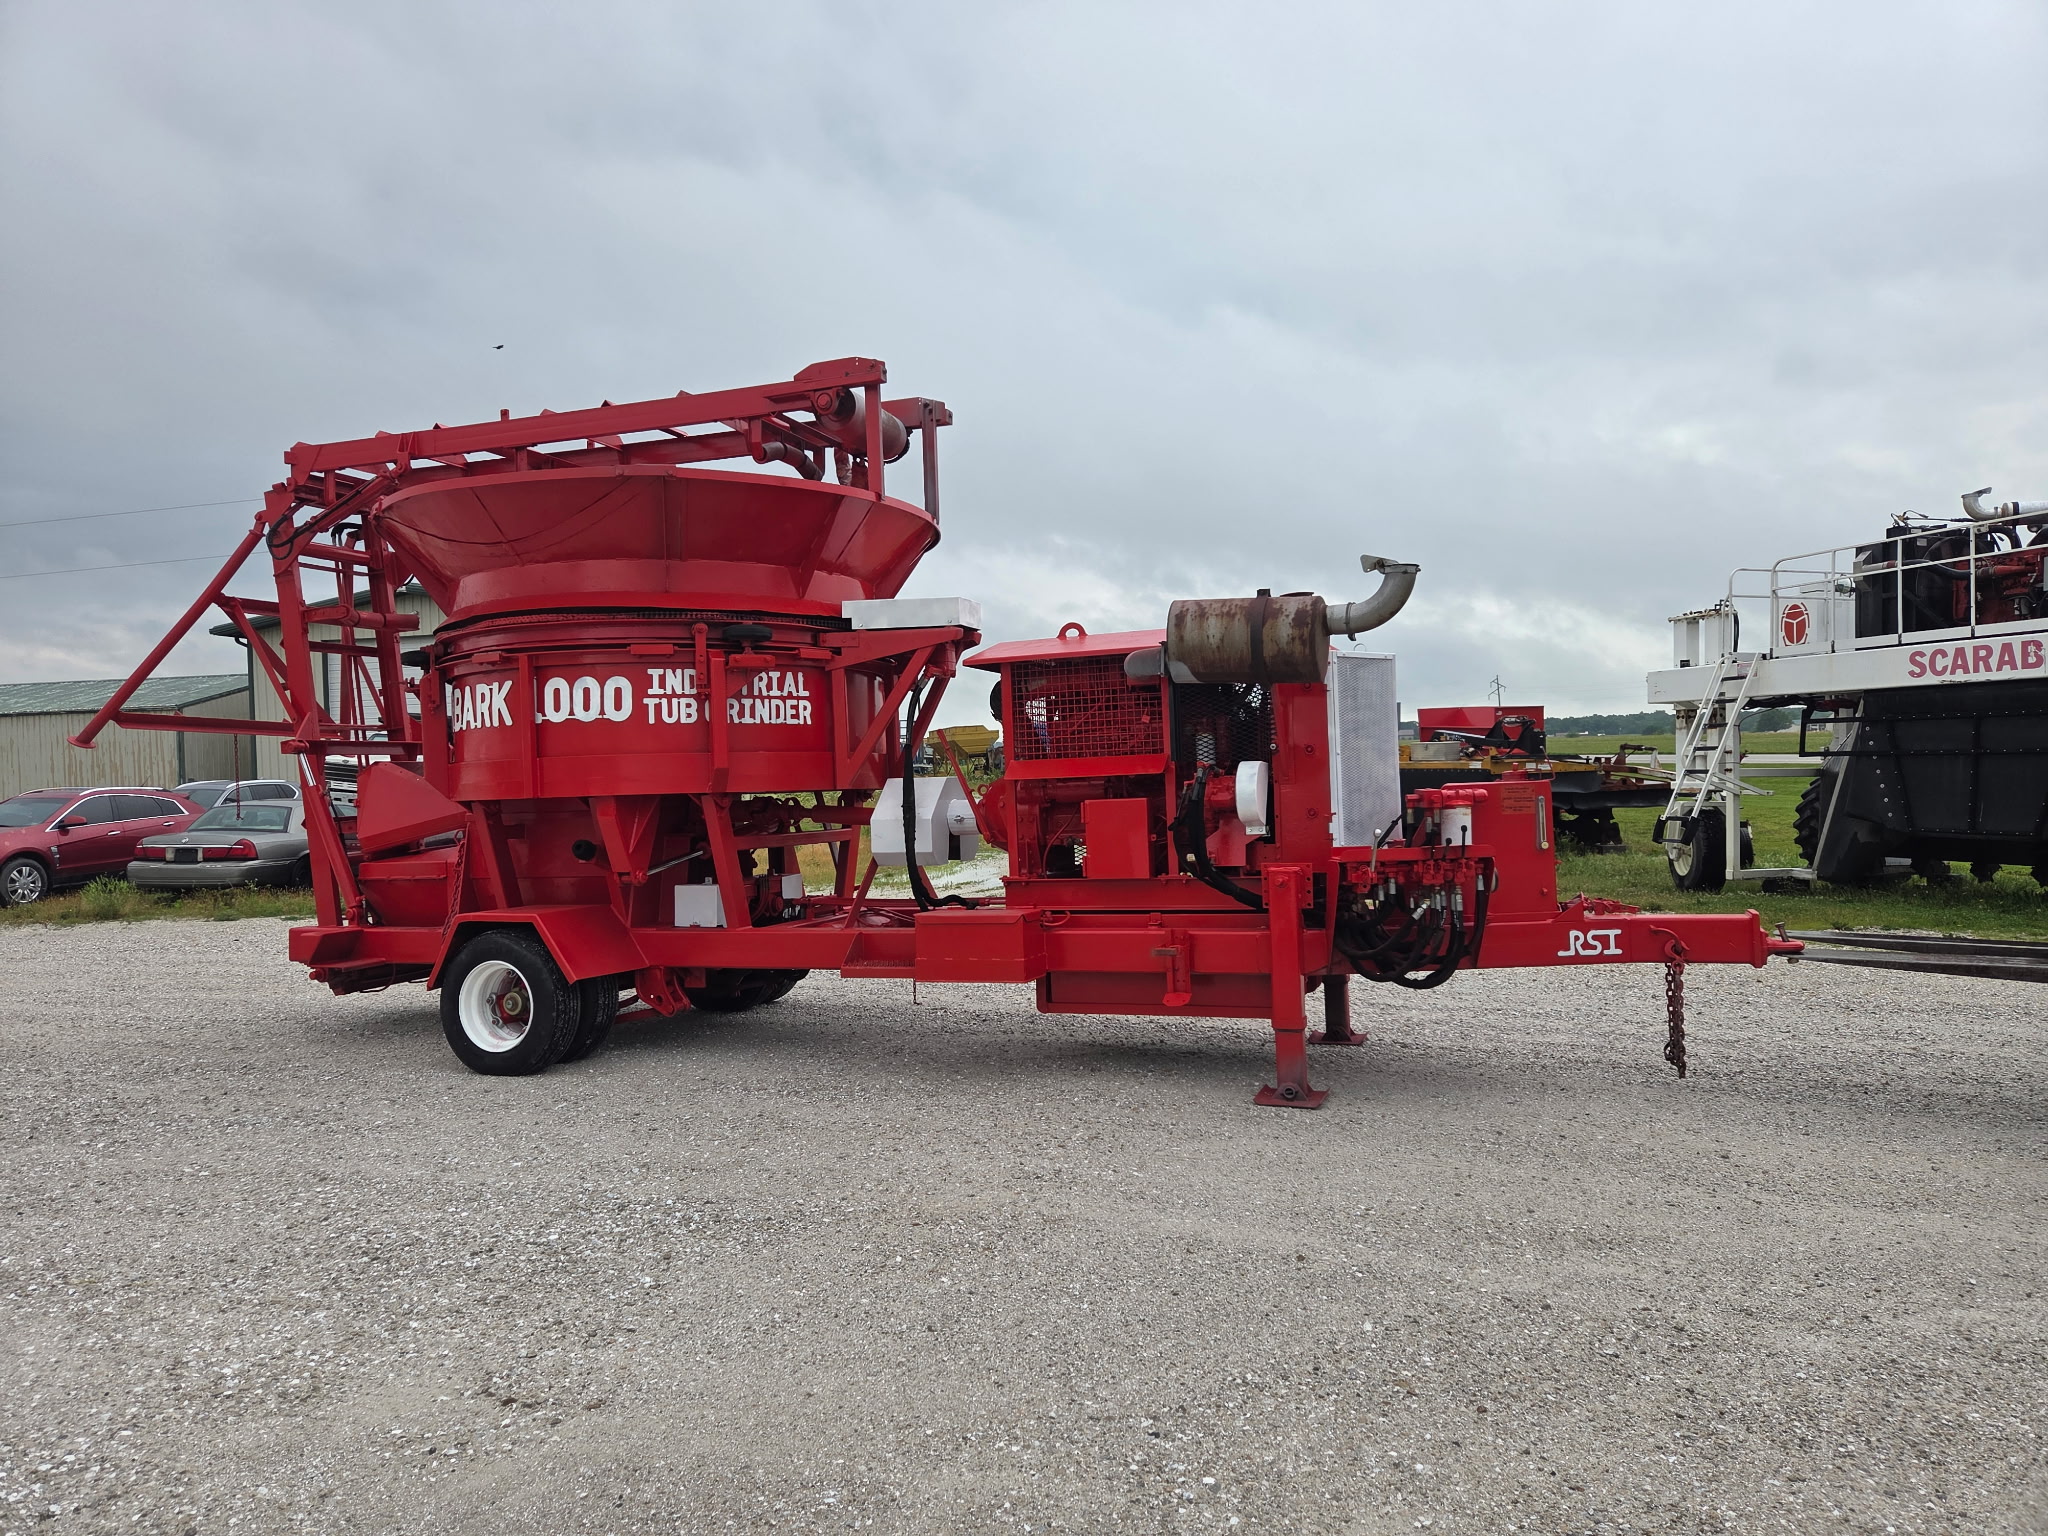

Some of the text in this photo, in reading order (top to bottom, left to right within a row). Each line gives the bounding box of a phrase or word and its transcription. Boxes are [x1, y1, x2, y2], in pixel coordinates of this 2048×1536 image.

[1907, 639, 2044, 679] SCARAB
[647, 668, 810, 697] INDRIAL
[453, 675, 633, 733] BARK 000
[643, 697, 812, 725] TUB RINDER
[1557, 929, 1623, 957] RSI
